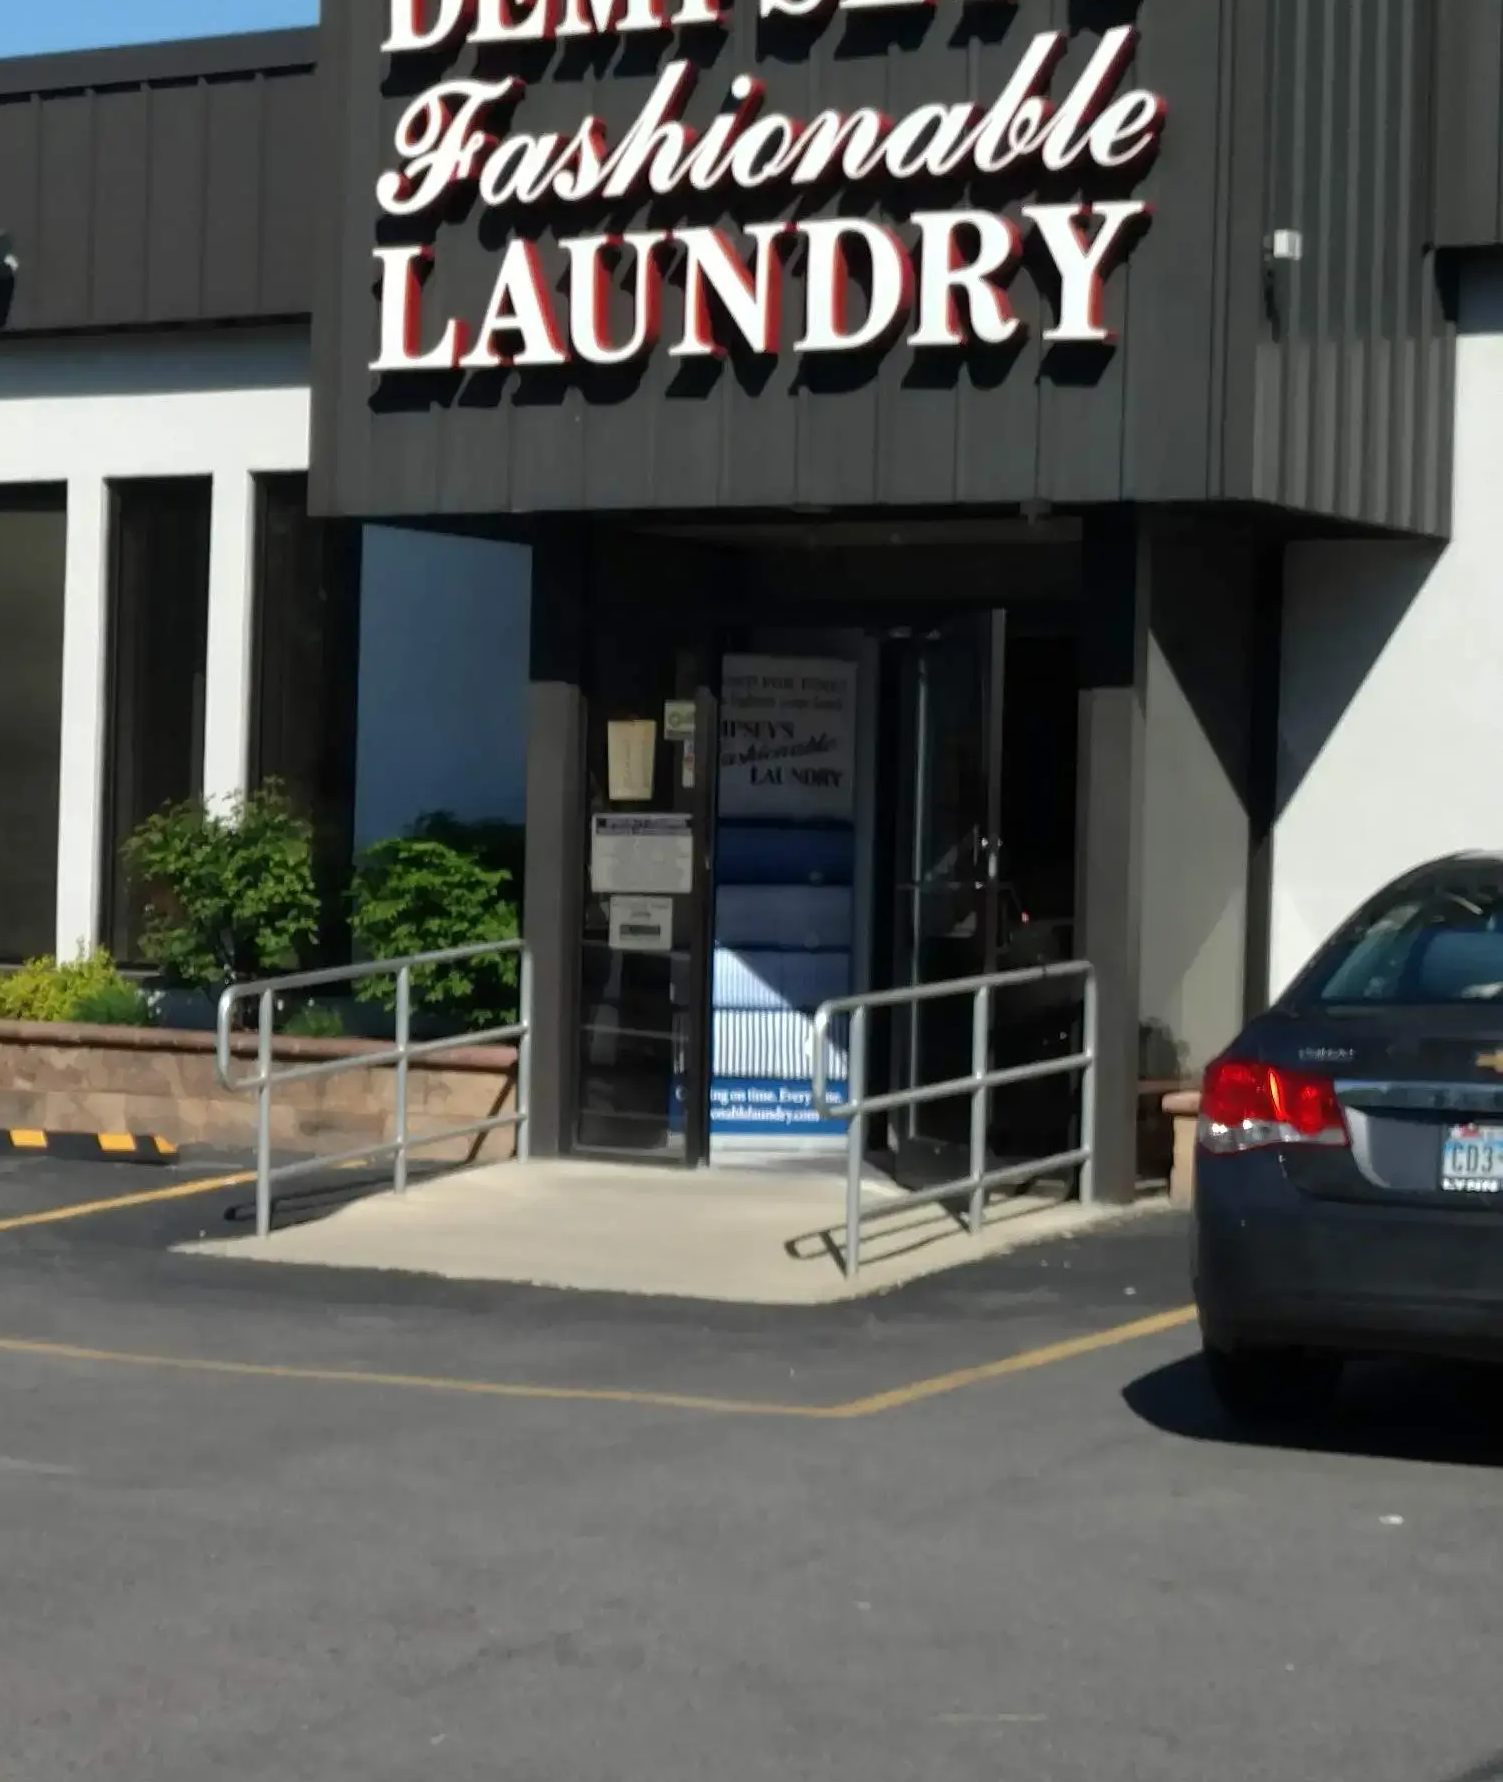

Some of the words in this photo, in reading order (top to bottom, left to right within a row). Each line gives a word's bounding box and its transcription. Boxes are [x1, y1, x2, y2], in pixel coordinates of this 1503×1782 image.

[376, 25, 1166, 216] Fashionable
[369, 200, 1153, 372] LAUNDRY
[749, 764, 843, 788] LAUNDRY
